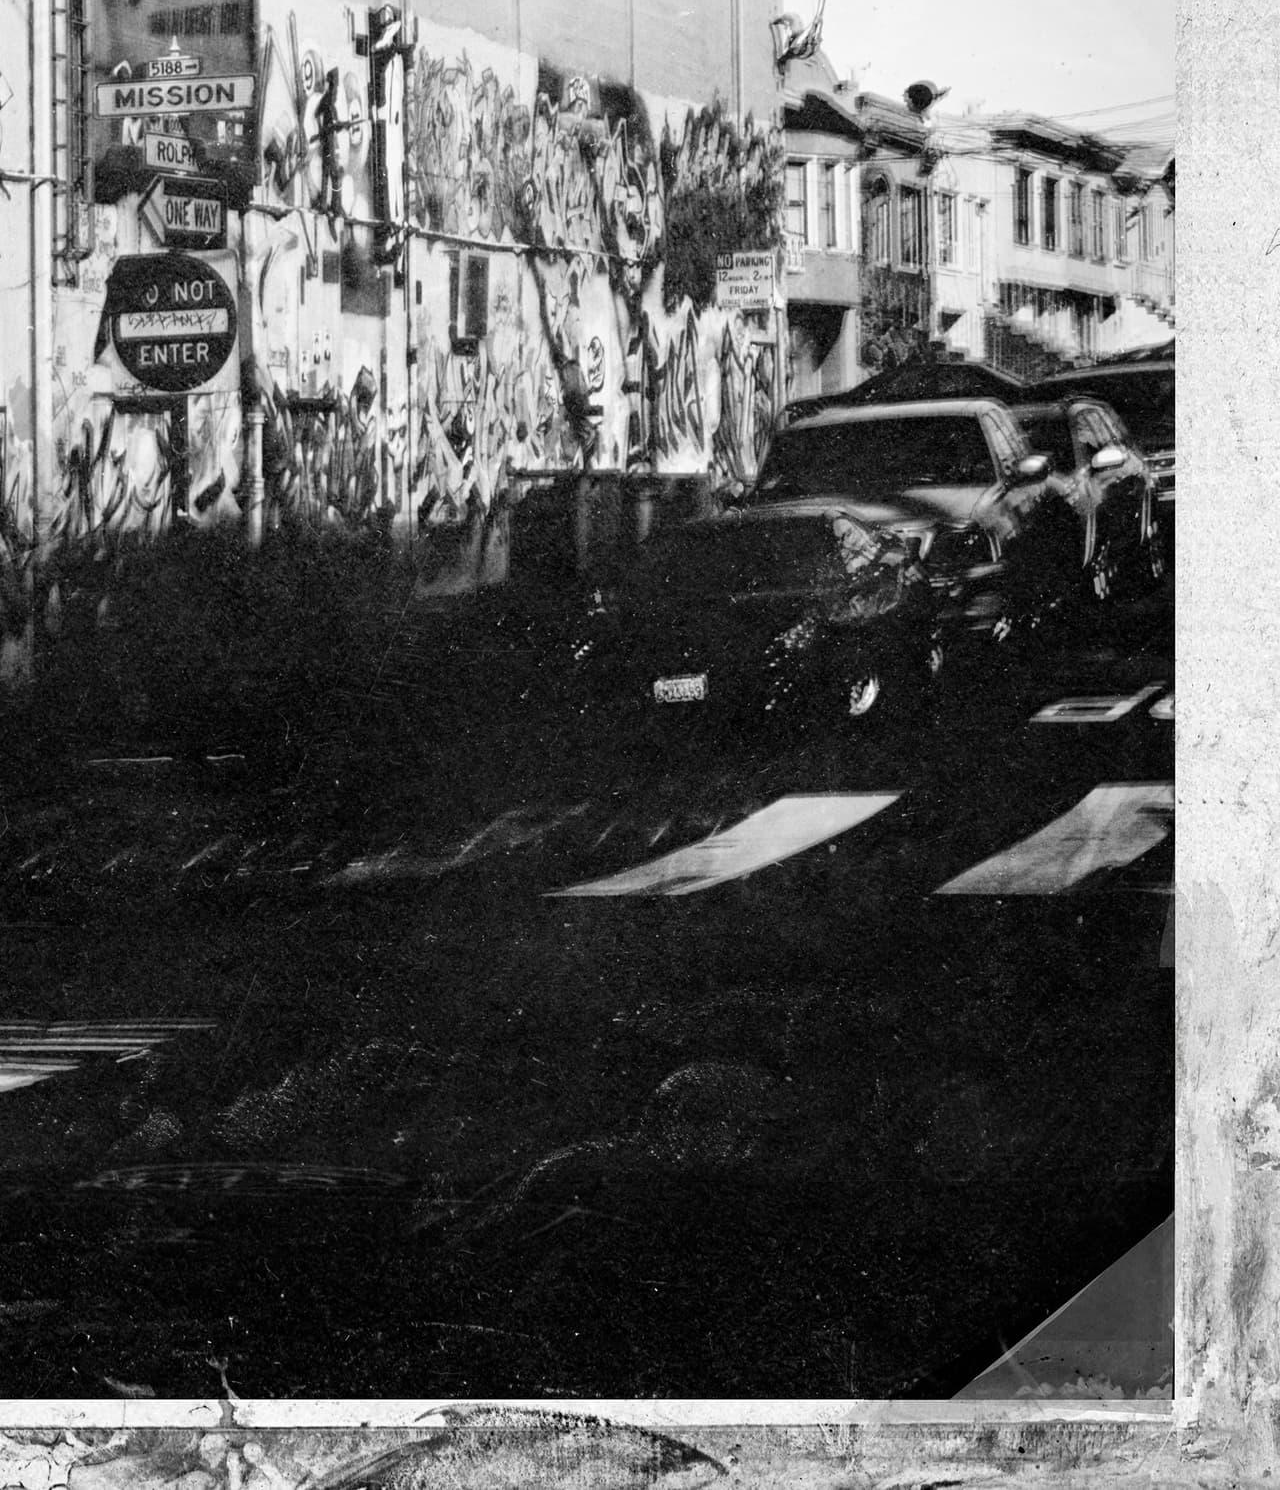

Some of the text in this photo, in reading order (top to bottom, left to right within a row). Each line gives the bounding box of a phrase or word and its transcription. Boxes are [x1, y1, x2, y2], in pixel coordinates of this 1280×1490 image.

[151, 60, 183, 77] 5188
[114, 82, 236, 108] MISSION
[165, 198, 219, 229] ONE WAY
[717, 253, 732, 268] NO
[174, 279, 217, 302] NOT
[729, 285, 759, 295] FRIDAY
[140, 342, 210, 366] ENTER
